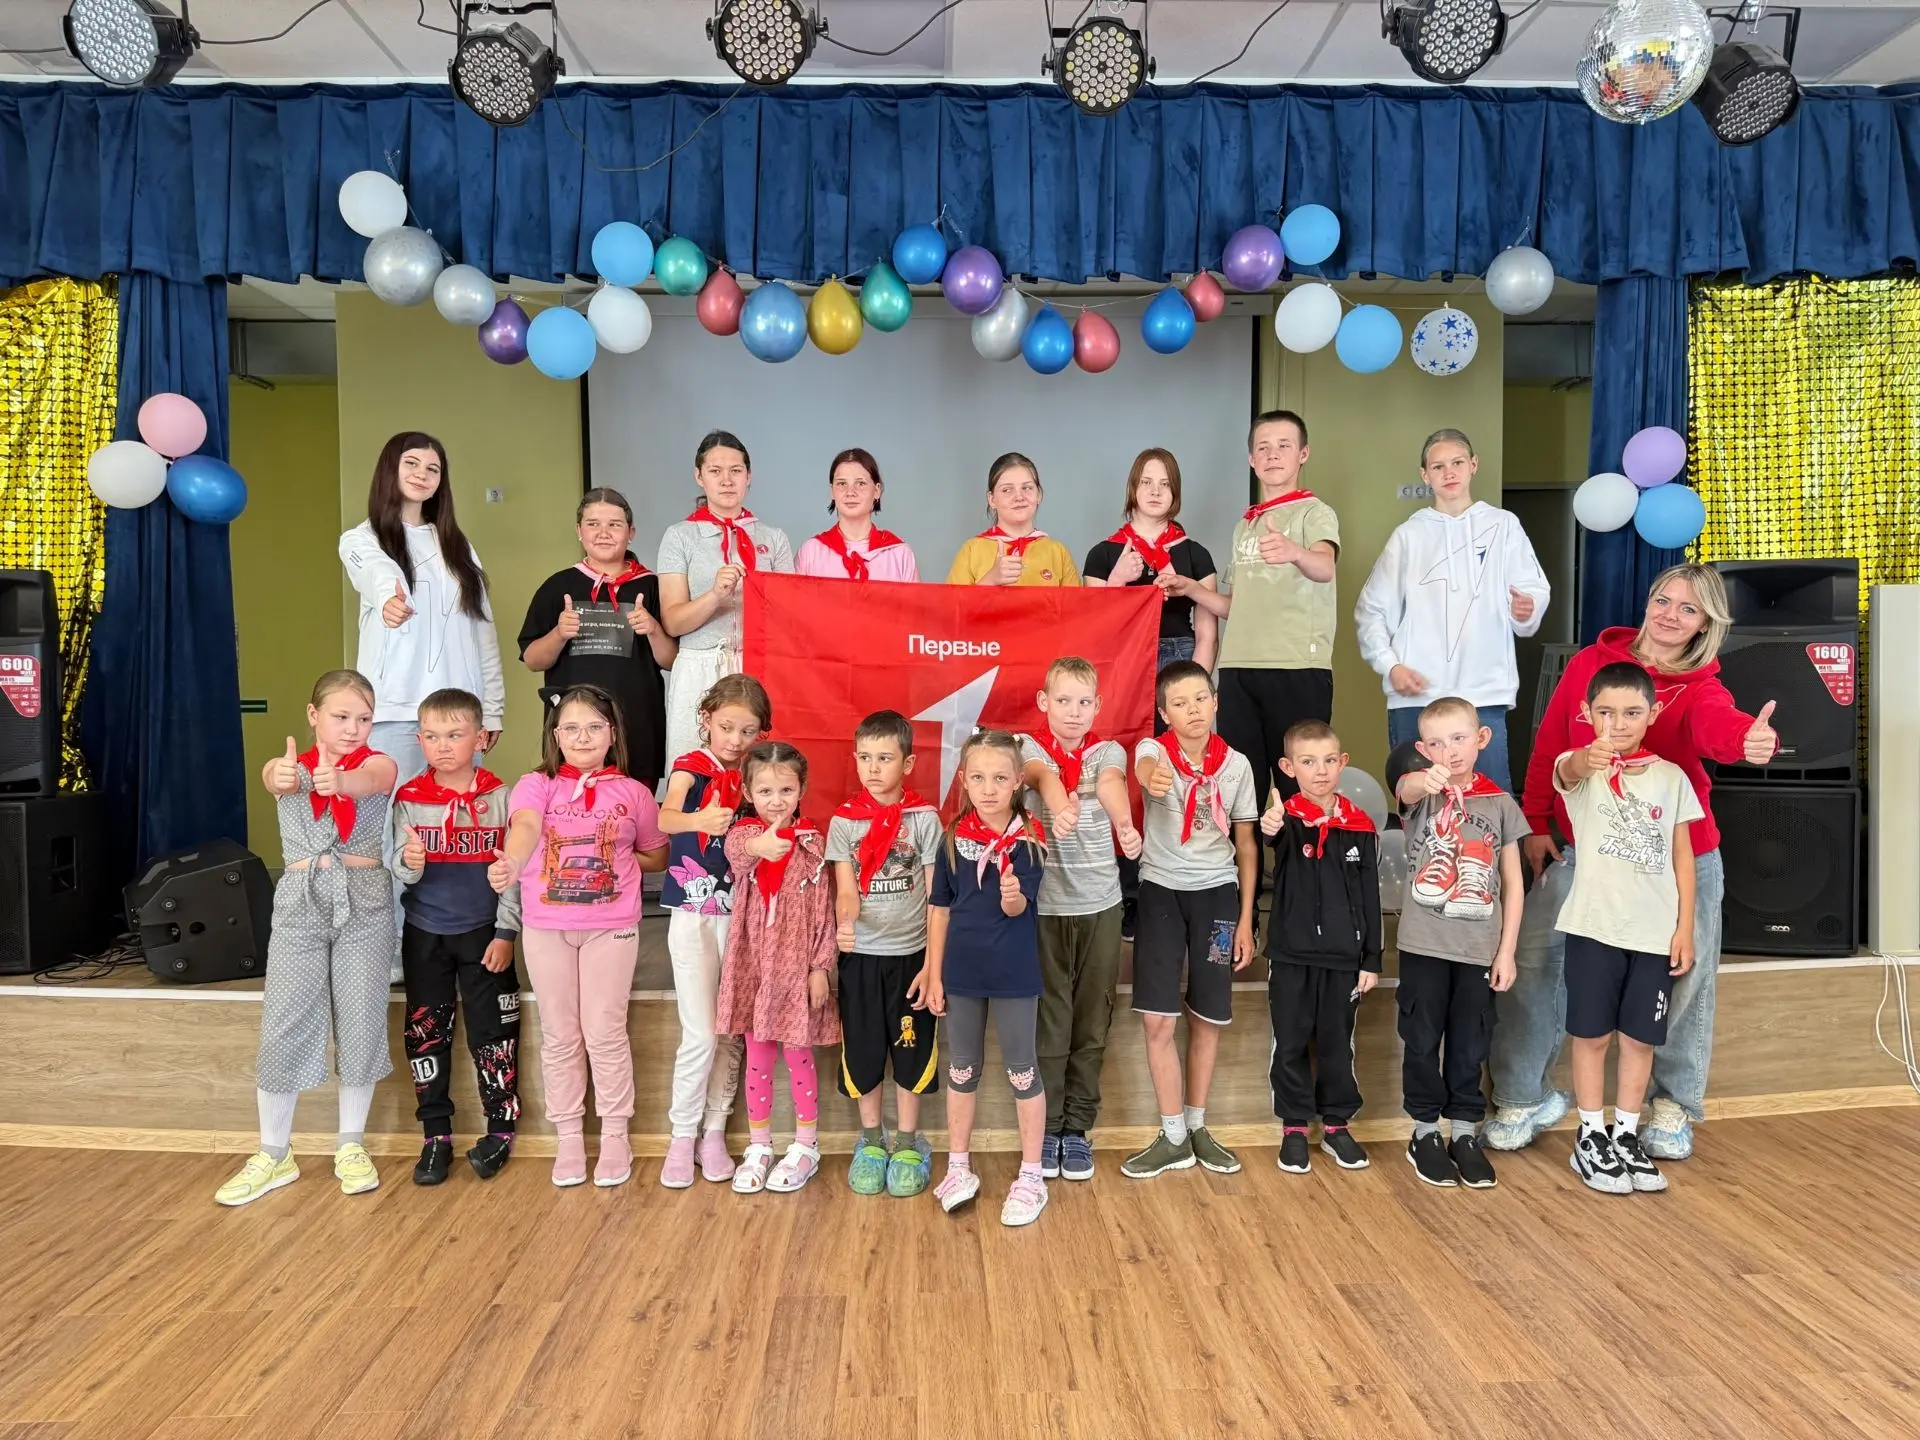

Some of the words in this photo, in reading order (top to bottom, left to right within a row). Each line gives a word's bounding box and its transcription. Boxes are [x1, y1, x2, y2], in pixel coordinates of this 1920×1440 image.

[908, 634, 1001, 661] Первые
[1813, 646, 1848, 659] 1600
[0, 658, 33, 671] 600
[545, 804, 619, 821] LONDON
[418, 829, 499, 855] USIA
[870, 879, 909, 893] ENTURE
